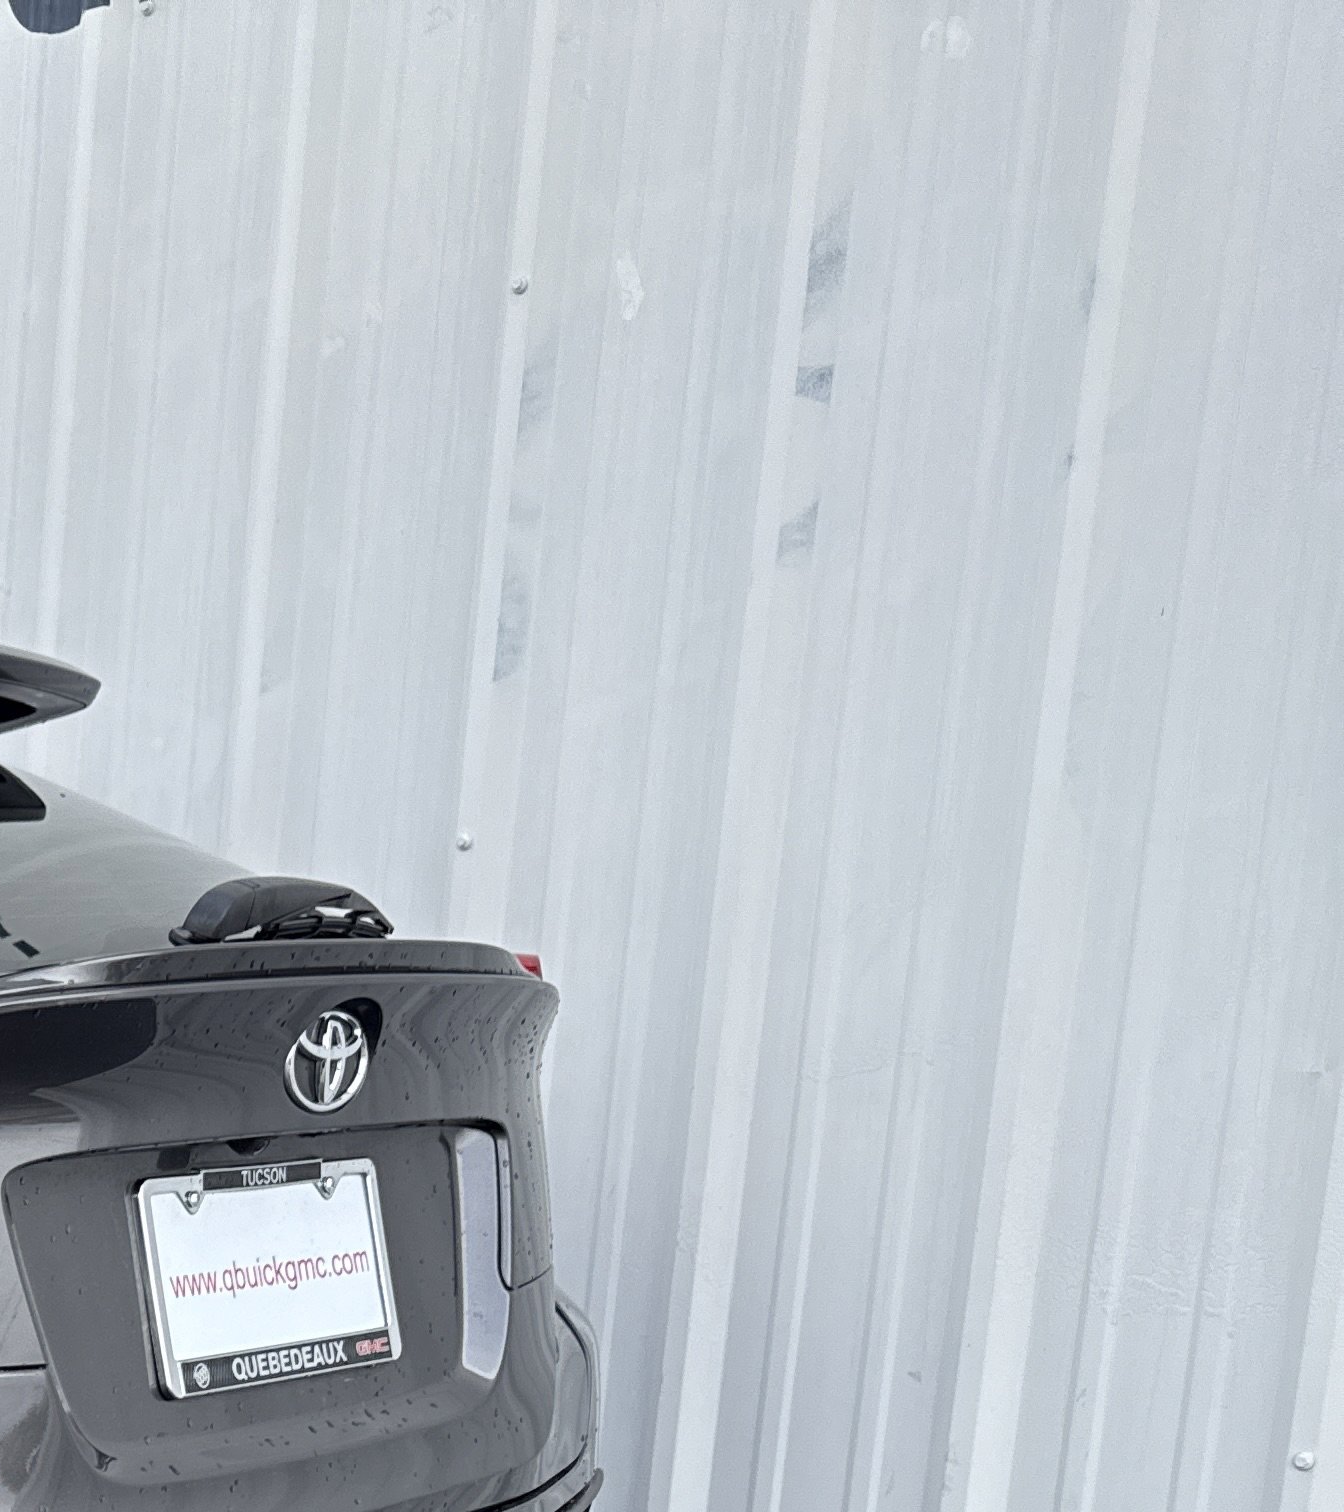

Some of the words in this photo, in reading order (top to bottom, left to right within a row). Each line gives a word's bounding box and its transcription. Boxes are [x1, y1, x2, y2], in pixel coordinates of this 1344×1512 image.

[240, 1166, 288, 1187] TUCSON
[170, 1250, 371, 1299] www.qbuickgmc.com
[231, 1340, 349, 1382] QUEBEDEAUX
[355, 1337, 390, 1356] GMC
